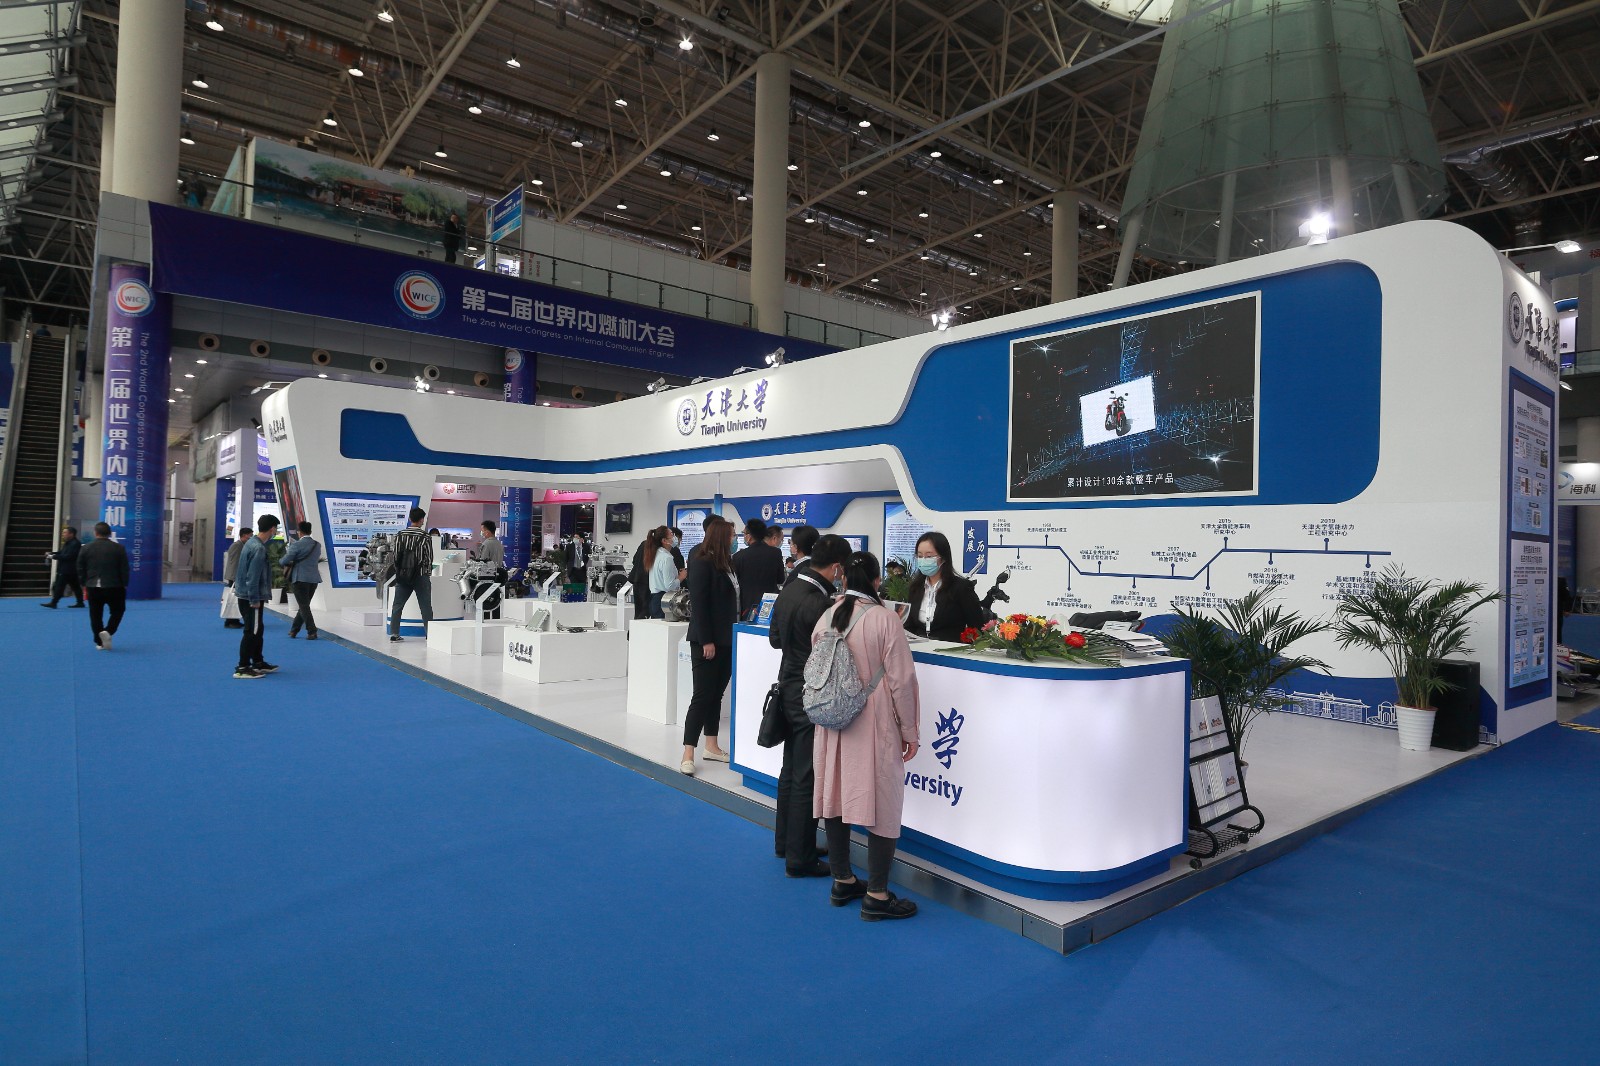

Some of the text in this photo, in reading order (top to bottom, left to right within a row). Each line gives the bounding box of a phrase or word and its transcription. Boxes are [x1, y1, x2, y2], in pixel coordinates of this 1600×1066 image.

[124, 295, 147, 304] WICE
[411, 291, 437, 303] WICE
[462, 286, 675, 348] 第二届世界内燃机大会
[462, 315, 477, 324] The
[480, 319, 496, 328] 2nd
[499, 321, 523, 332] World
[525, 326, 561, 339] Congress
[575, 335, 604, 347] Internal
[605, 340, 647, 354] Combustion
[648, 348, 675, 359] Engines
[701, 379, 768, 420] 天津大学
[701, 417, 767, 438] Tianjin University
[132, 332, 150, 572] The 2nd World Congress on Internal Combustion Engines
[1067, 472, 1174, 488] 累计设计130余款整车产品
[1570, 484, 1597, 495] 海科
[774, 500, 807, 516] 天津大学
